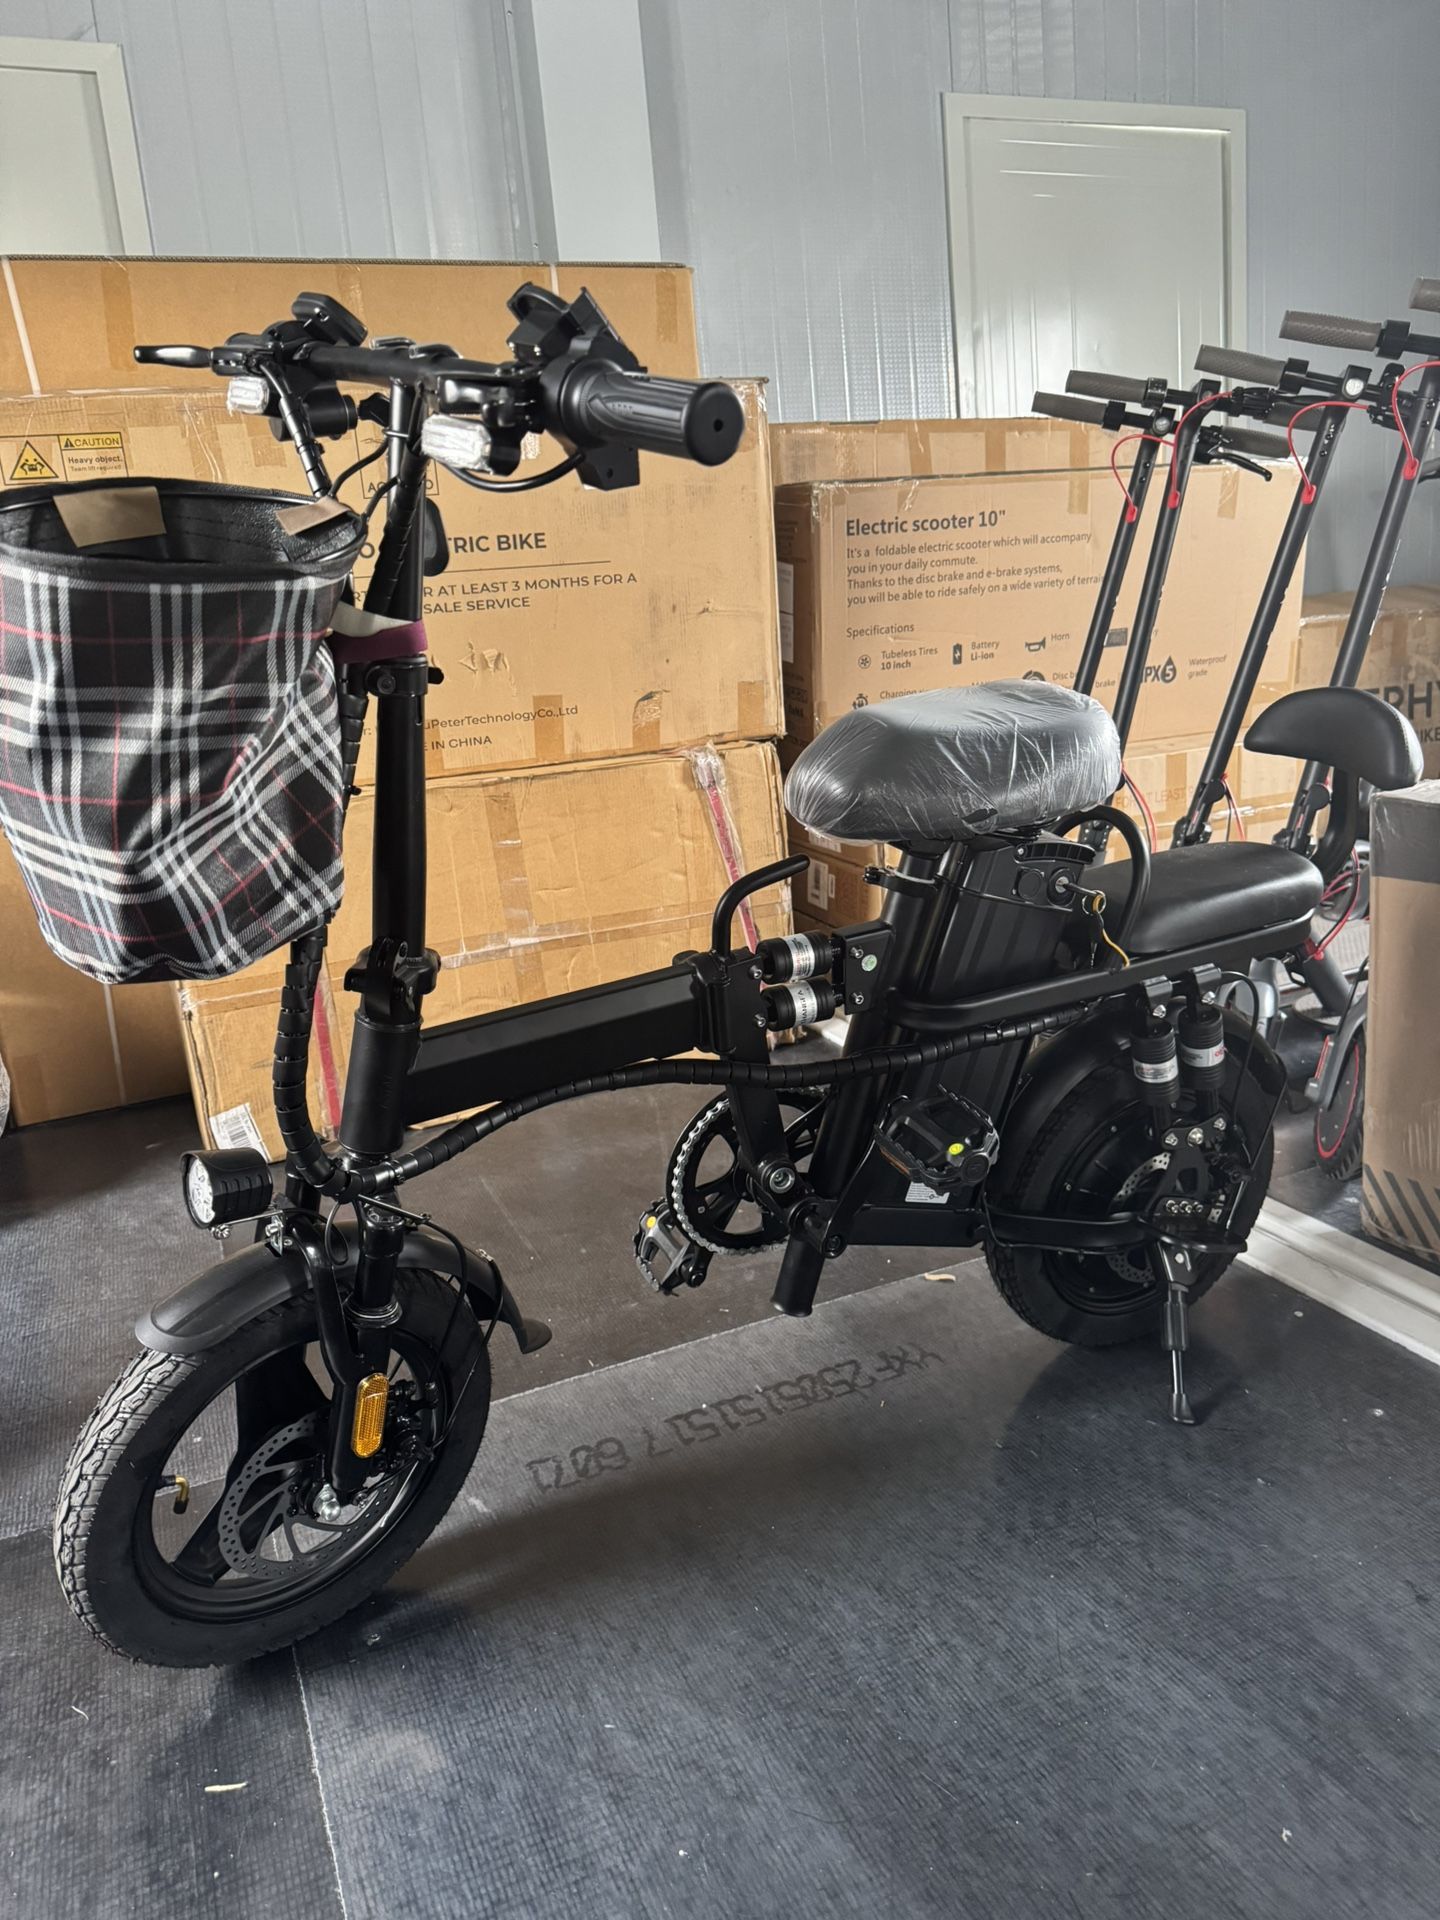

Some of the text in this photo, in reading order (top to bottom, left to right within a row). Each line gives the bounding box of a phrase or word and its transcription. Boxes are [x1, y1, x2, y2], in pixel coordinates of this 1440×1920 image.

[75, 438, 119, 446] CAUTION
[68, 456, 122, 464] Heavy object.
[846, 510, 1006, 536] Electric scooter 10"
[496, 532, 548, 550] BIKE
[847, 533, 1092, 558] It's a foldable electric scooter which will accompany
[847, 556, 978, 577] you in your daily commute.
[437, 585, 458, 596] AT
[462, 582, 508, 596] LEAST
[512, 580, 520, 592] 3
[525, 576, 590, 590] MONTHS
[594, 574, 623, 586] FOR
[626, 573, 637, 584] A
[848, 564, 1062, 590] Thanks to the disc brake and e-brake systems,
[847, 596, 866, 608] you
[868, 592, 885, 603] will
[888, 591, 900, 601] be
[902, 588, 922, 601] able
[925, 589, 935, 598] to
[938, 586, 956, 597] ride
[958, 582, 985, 597] safely
[988, 584, 1000, 593] on
[1010, 580, 1032, 591] wide
[1034, 578, 1064, 590] variety
[1066, 575, 1076, 586] of
[466, 596, 531, 611] SERVICE
[846, 622, 914, 640] Specifications
[881, 632, 1070, 660] Tubeless Tires Battery Horn
[880, 652, 994, 671] 10 inch Li-ion
[1189, 654, 1227, 666] Waterproof
[1052, 672, 1069, 681] Disc
[1188, 669, 1208, 679] grade
[1095, 679, 1116, 689] brake
[431, 740, 445, 750] IN
[450, 735, 492, 748] CHINA
[1155, 788, 1186, 803] LEAST
